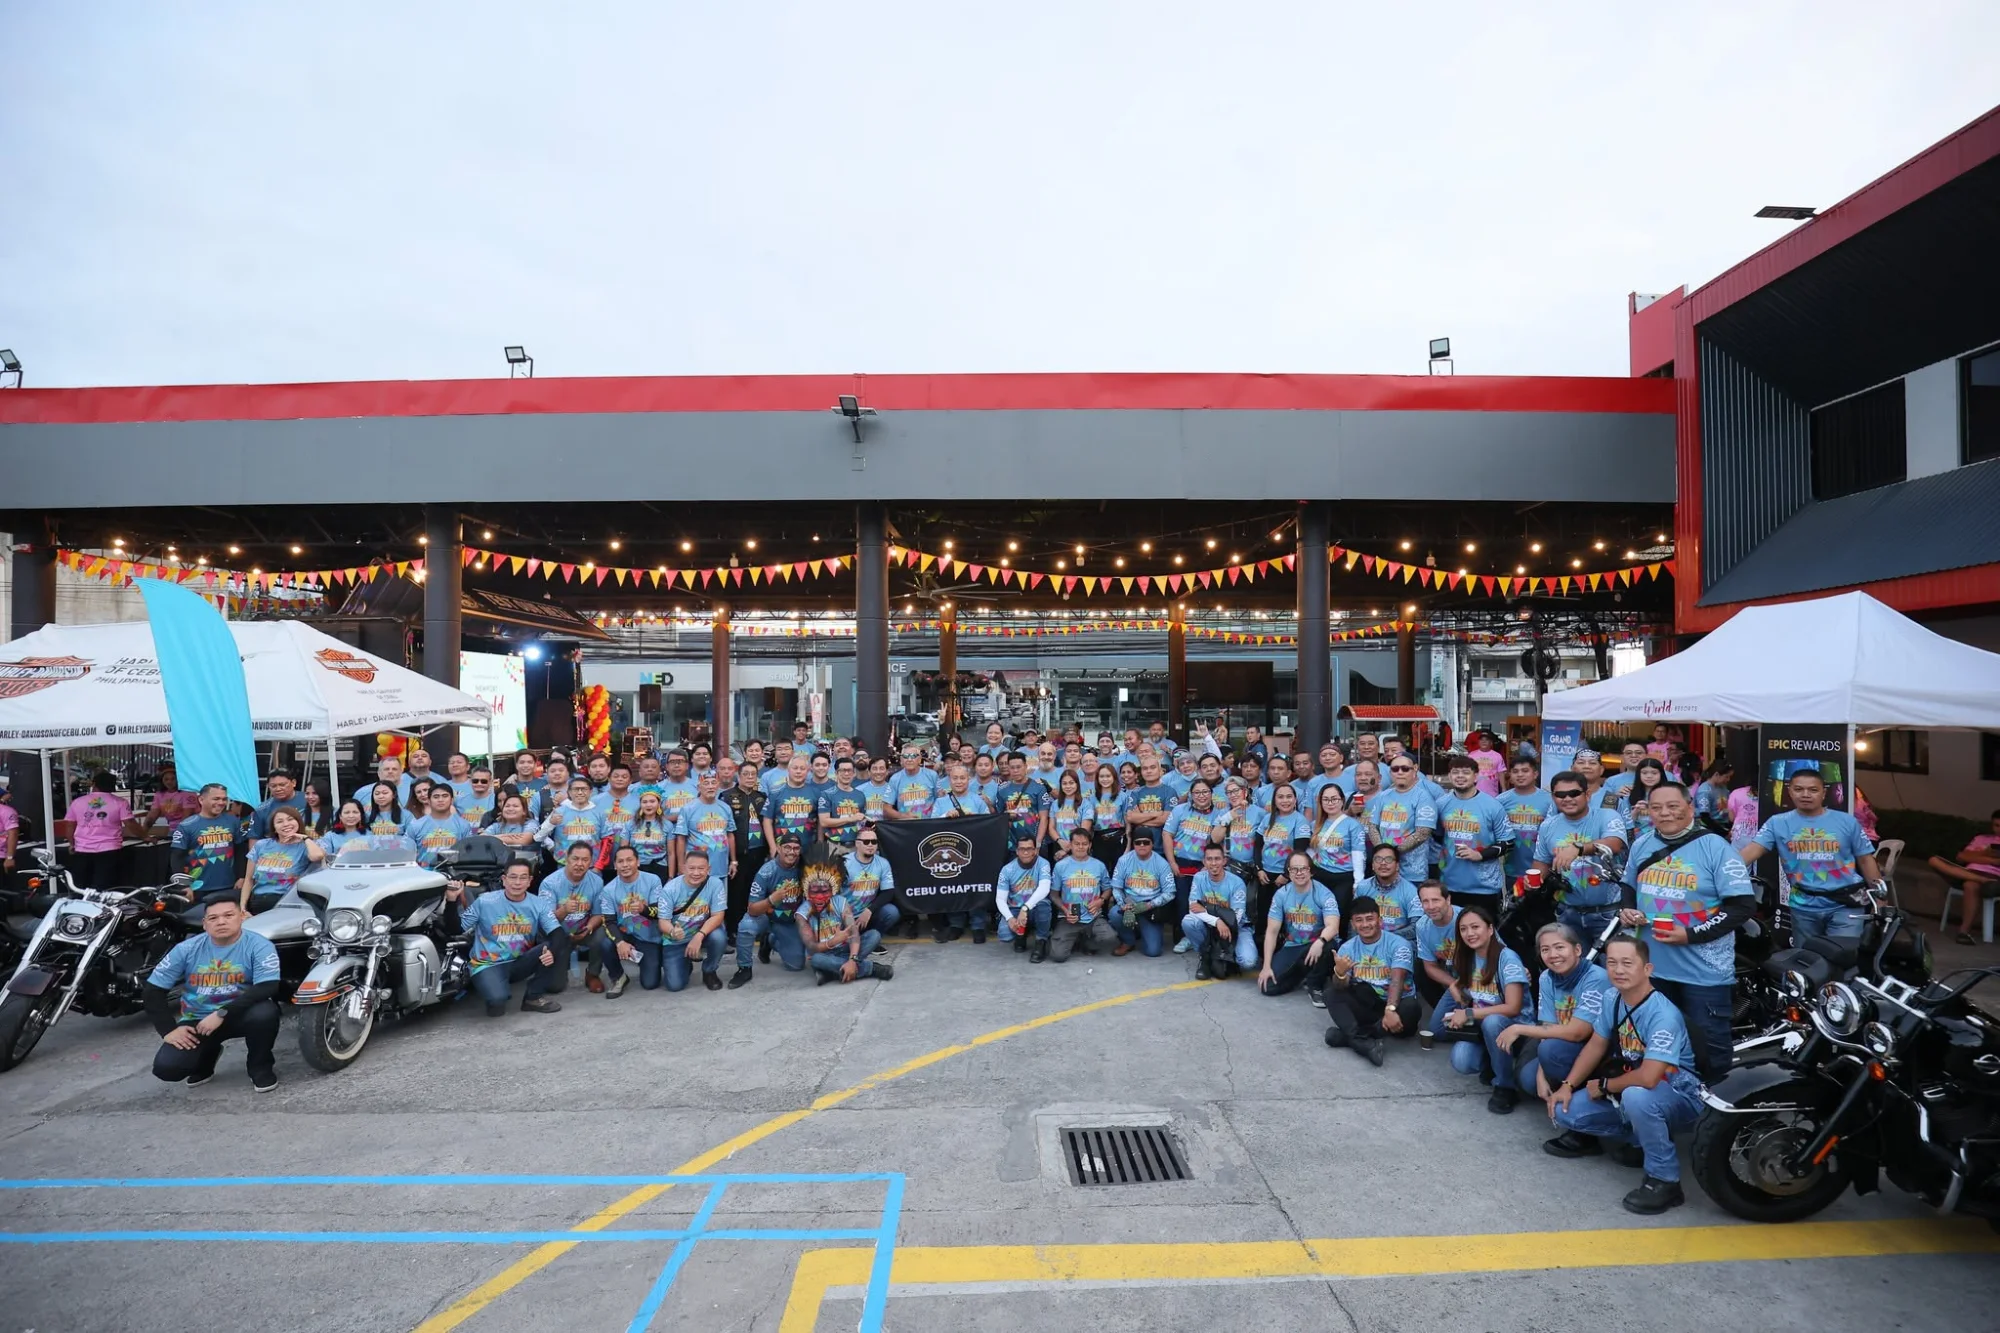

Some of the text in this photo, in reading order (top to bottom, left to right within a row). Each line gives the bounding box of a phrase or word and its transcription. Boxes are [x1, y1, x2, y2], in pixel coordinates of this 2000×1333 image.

[1643, 699, 1672, 718] World
[284, 721, 293, 730] OF
[294, 720, 312, 730] CEBU
[1550, 734, 1572, 744] GRAND
[1768, 739, 1841, 752] EPIC REWARDS
[1787, 840, 1841, 854] SINULOG
[905, 883, 992, 897] CEBU CHAPTER
[1641, 883, 1687, 899] RIDE 2025
[189, 972, 246, 986] SINULOG
[214, 985, 238, 995] 2025
